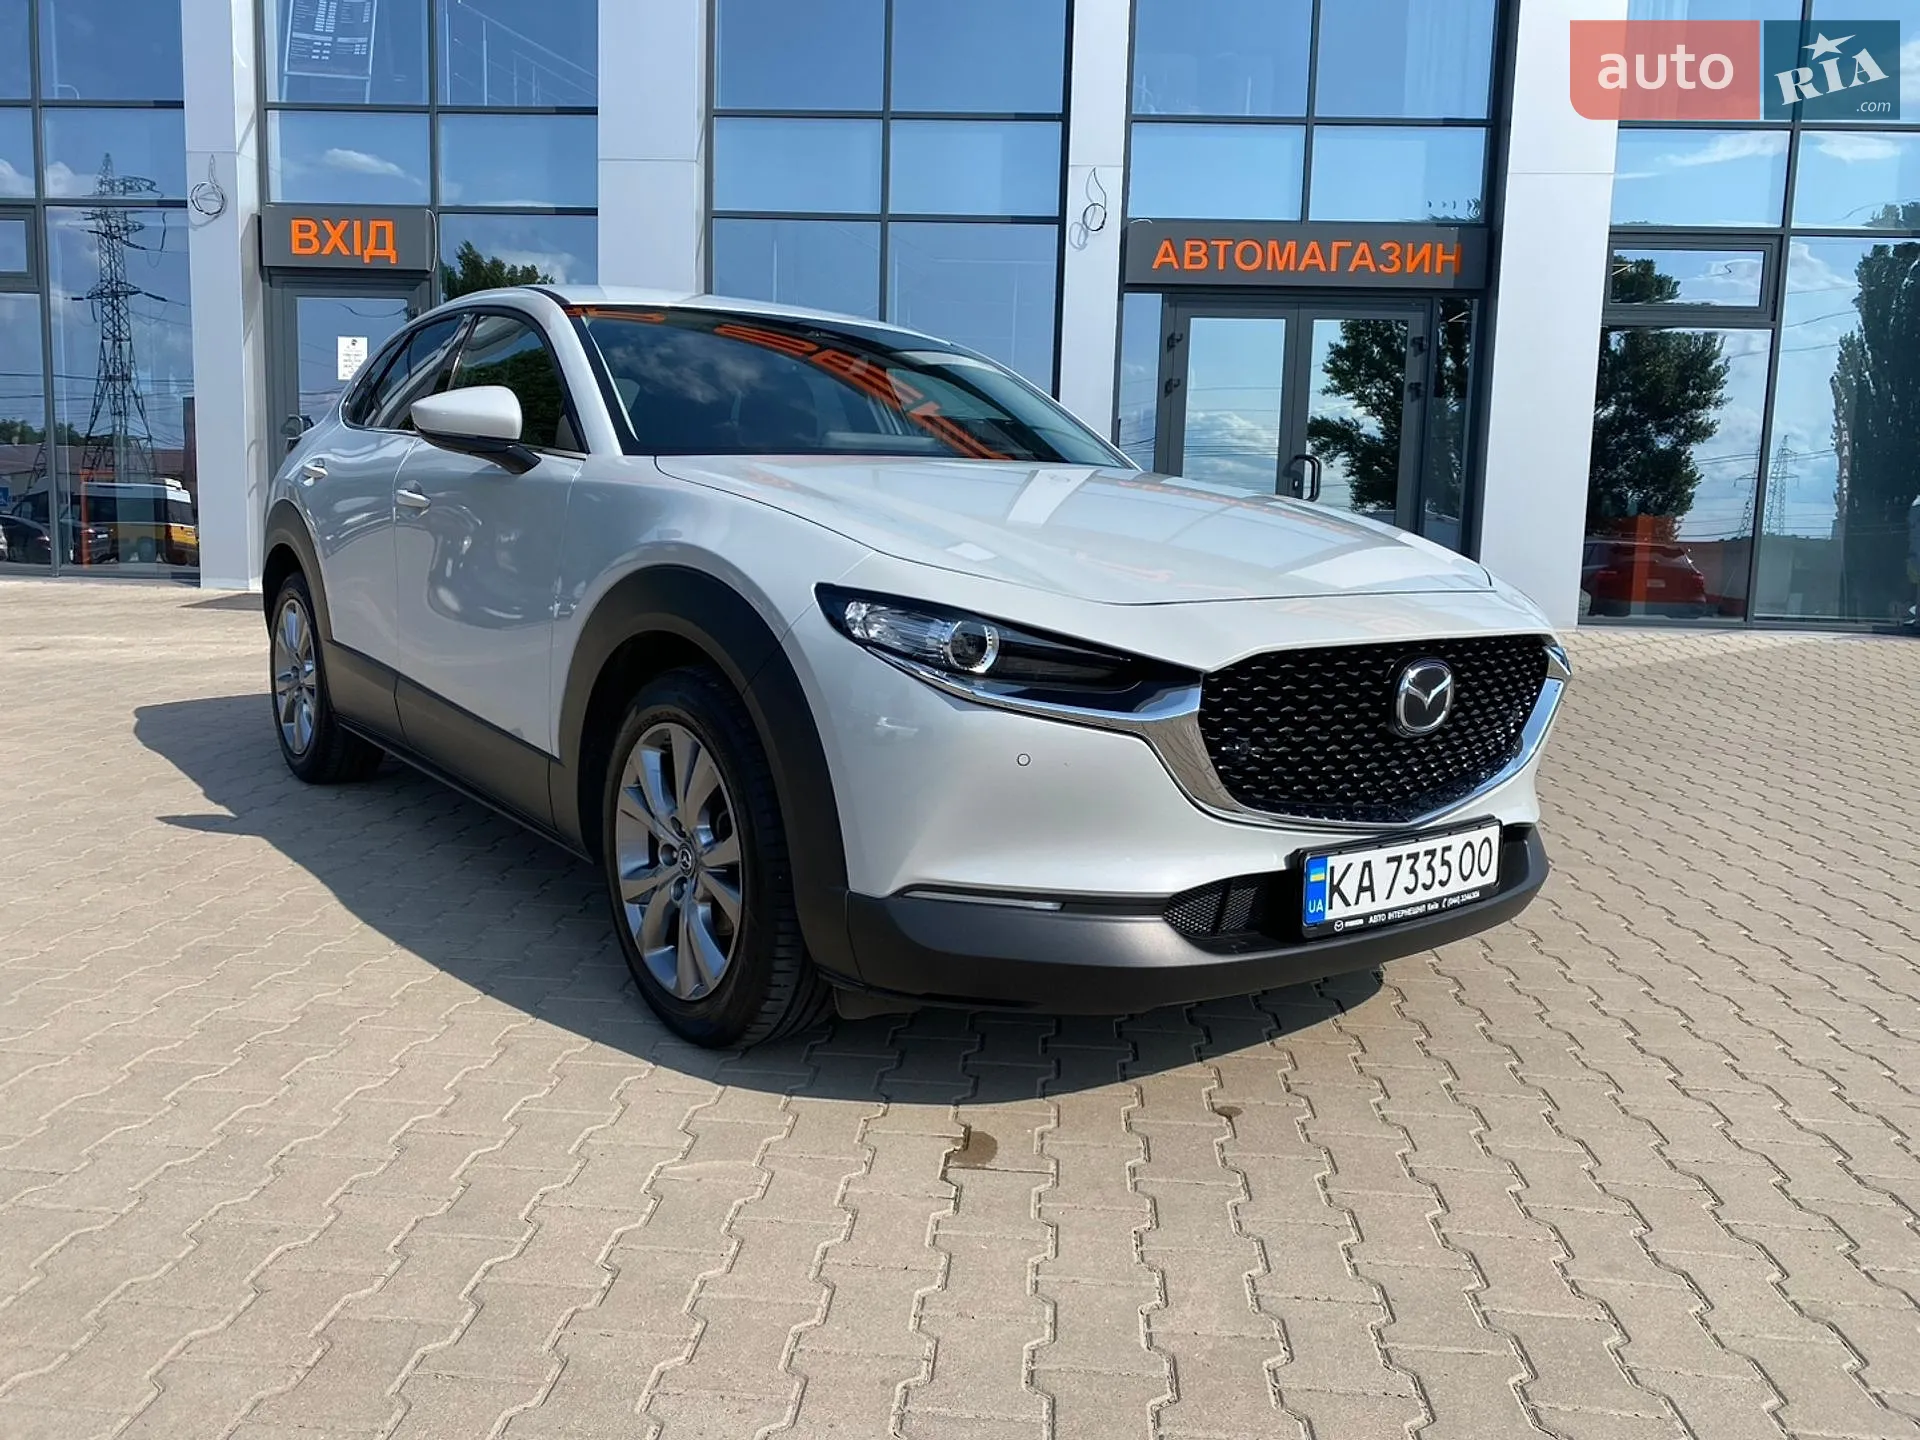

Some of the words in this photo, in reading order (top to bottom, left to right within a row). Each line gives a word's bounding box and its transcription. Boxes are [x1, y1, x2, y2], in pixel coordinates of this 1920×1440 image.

[290, 218, 398, 265] ВХІД
[1152, 239, 1462, 275] АВТОМАГАЗИН
[1329, 860, 1376, 910] KA
[1386, 845, 1453, 900] 7335
[1308, 899, 1324, 914] UA
